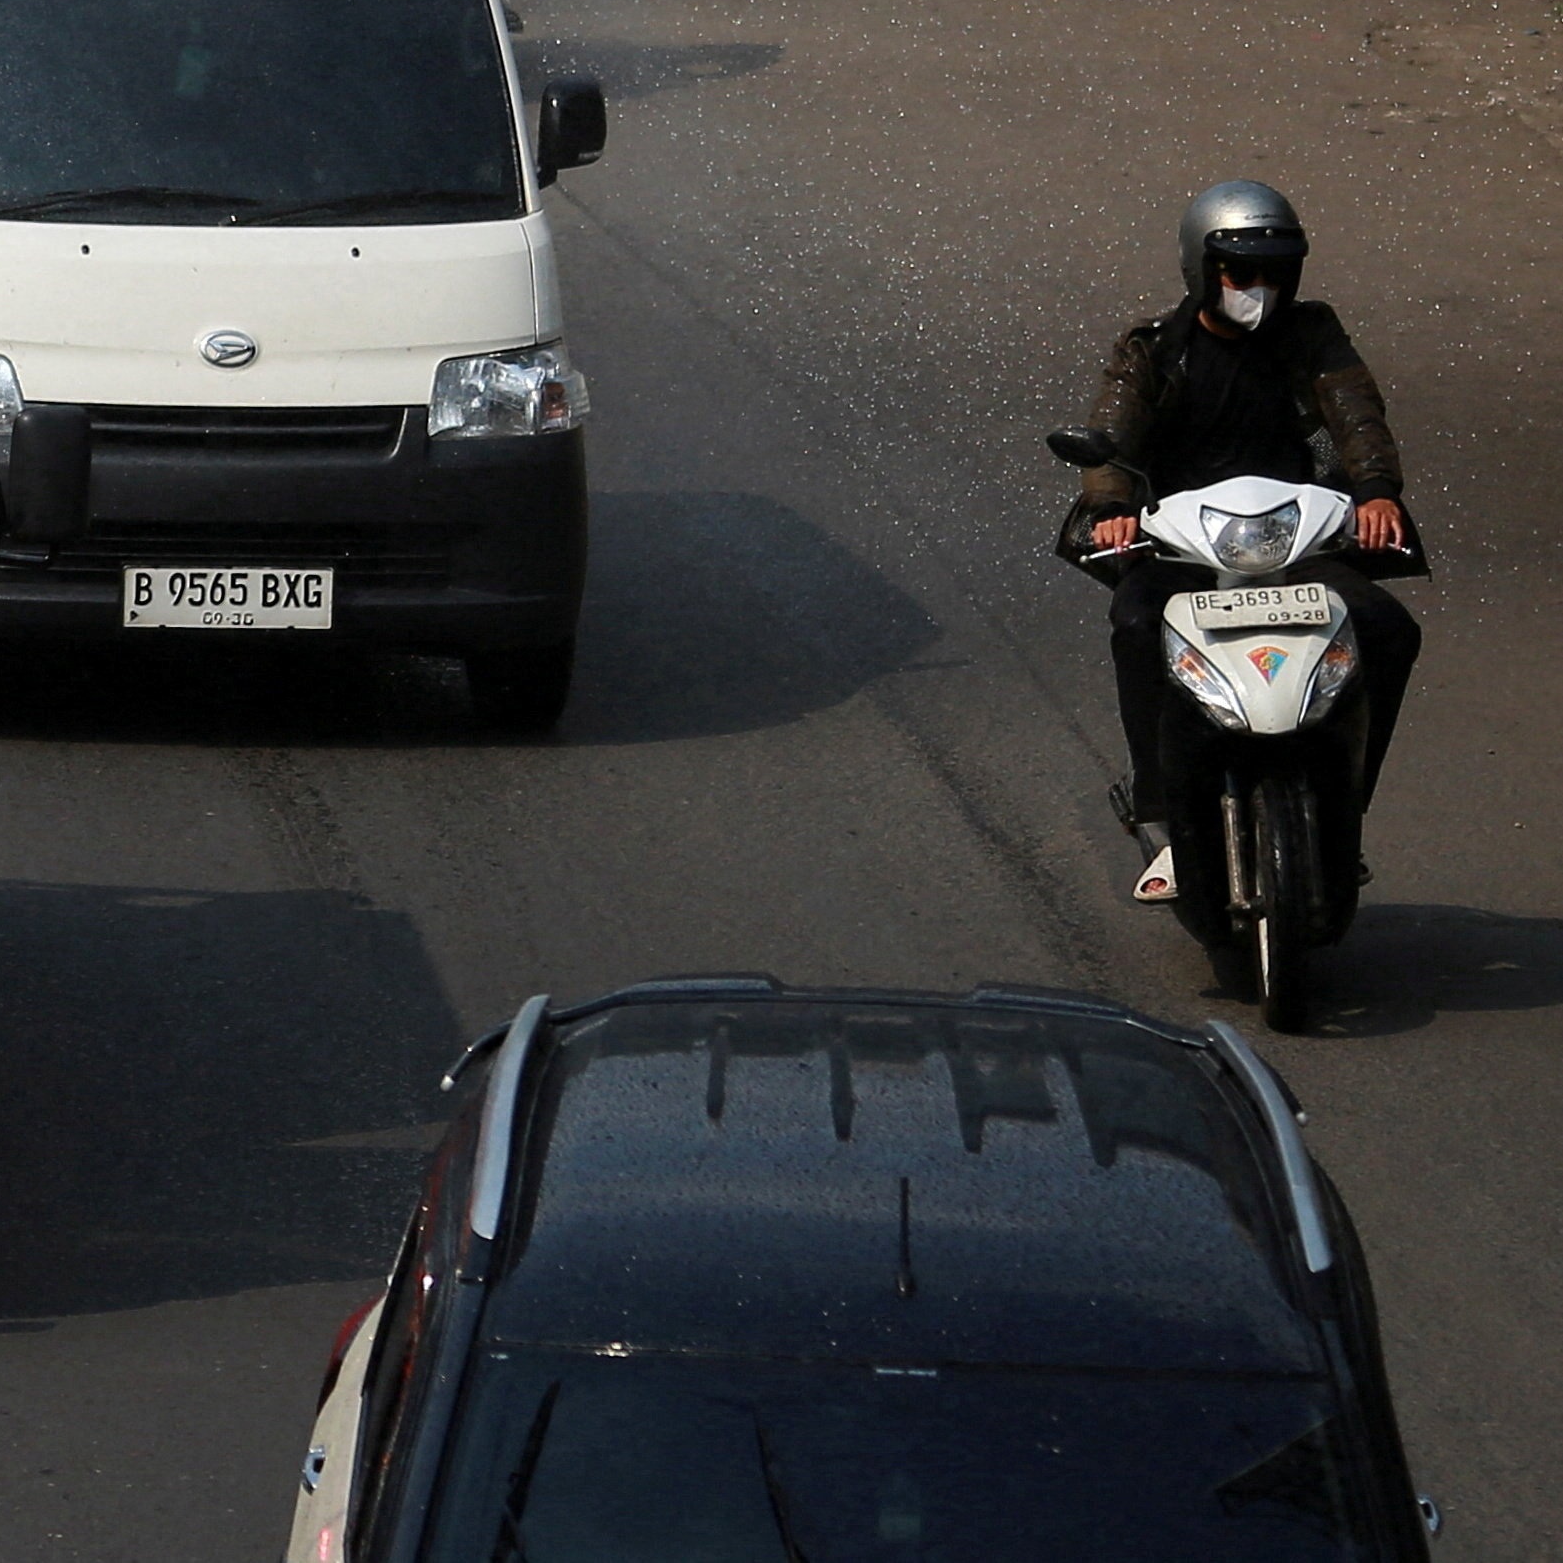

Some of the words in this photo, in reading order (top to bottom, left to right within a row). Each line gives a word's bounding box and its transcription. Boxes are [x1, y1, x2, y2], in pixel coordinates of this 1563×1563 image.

[134, 573, 153, 606] B
[169, 573, 249, 606] 9565
[261, 573, 323, 608] BXG
[1195, 594, 1224, 610] BE
[1232, 590, 1283, 607] 3693
